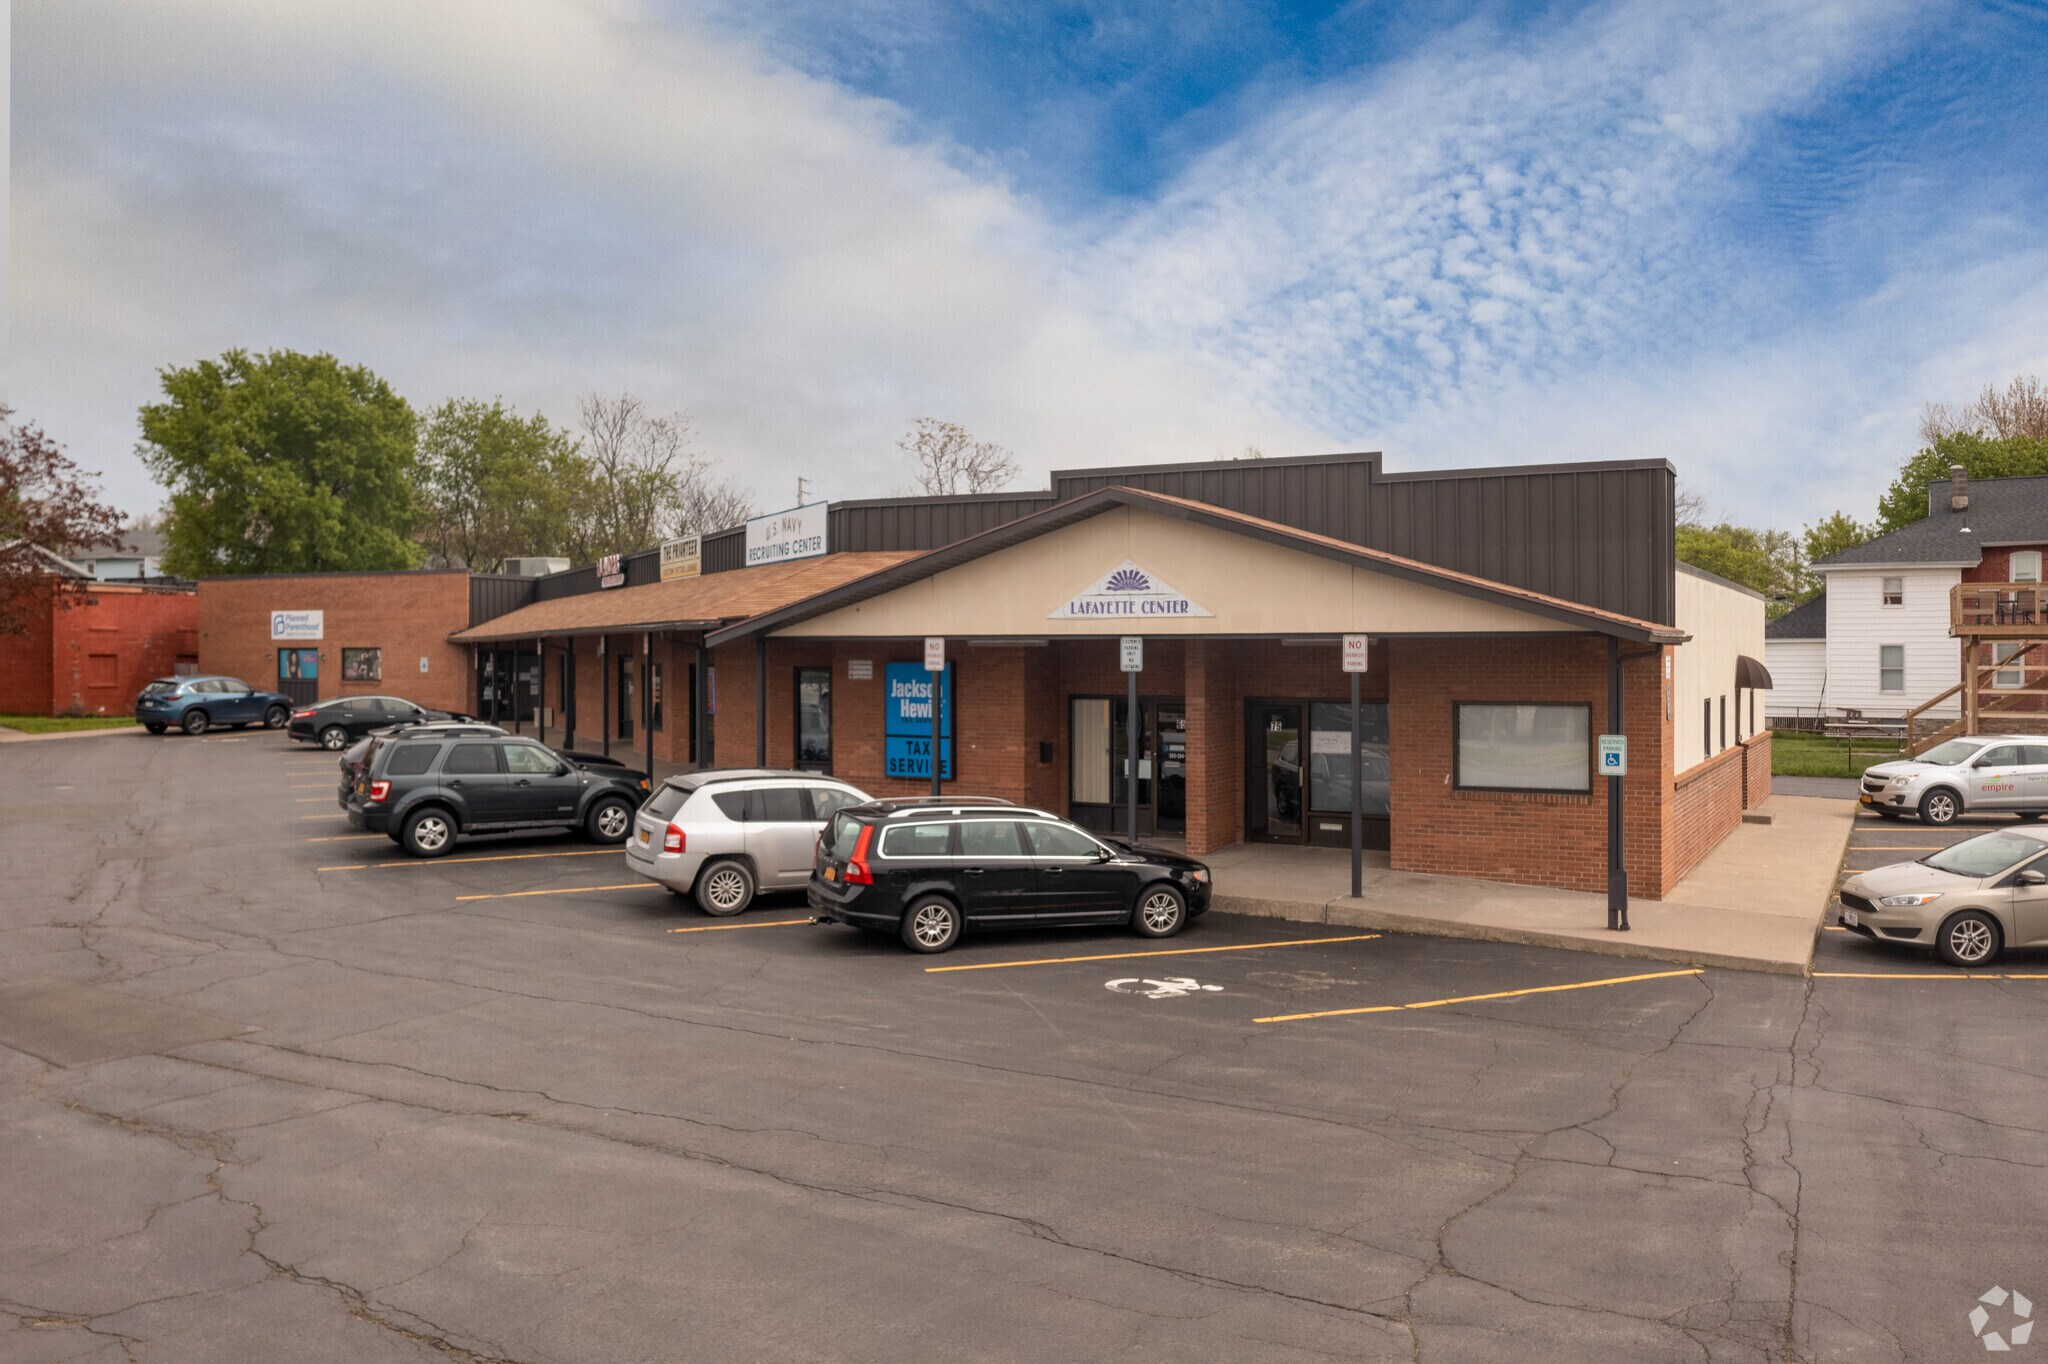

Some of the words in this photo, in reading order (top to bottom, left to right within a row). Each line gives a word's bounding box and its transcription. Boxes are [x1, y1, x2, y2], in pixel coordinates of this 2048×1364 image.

[765, 521, 779, 541] U.S.
[781, 516, 802, 534] NAVY
[663, 544, 671, 562] THE
[672, 538, 698, 559] PRIVATEER
[748, 541, 790, 561] RECRUITING
[792, 535, 822, 554] CENTER
[1070, 601, 1136, 615] LAFAYETTE
[1141, 600, 1189, 614] CENTER
[285, 614, 309, 622] Planned
[285, 623, 320, 631] Parenthood
[929, 642, 940, 650] NO
[1348, 640, 1362, 649] NO
[891, 679, 943, 698] Jackso
[900, 699, 943, 718] Hewi
[1270, 721, 1282, 732] 75
[906, 741, 930, 756] TAX
[890, 758, 947, 774] SERVIE
[1981, 783, 2015, 793] empire
